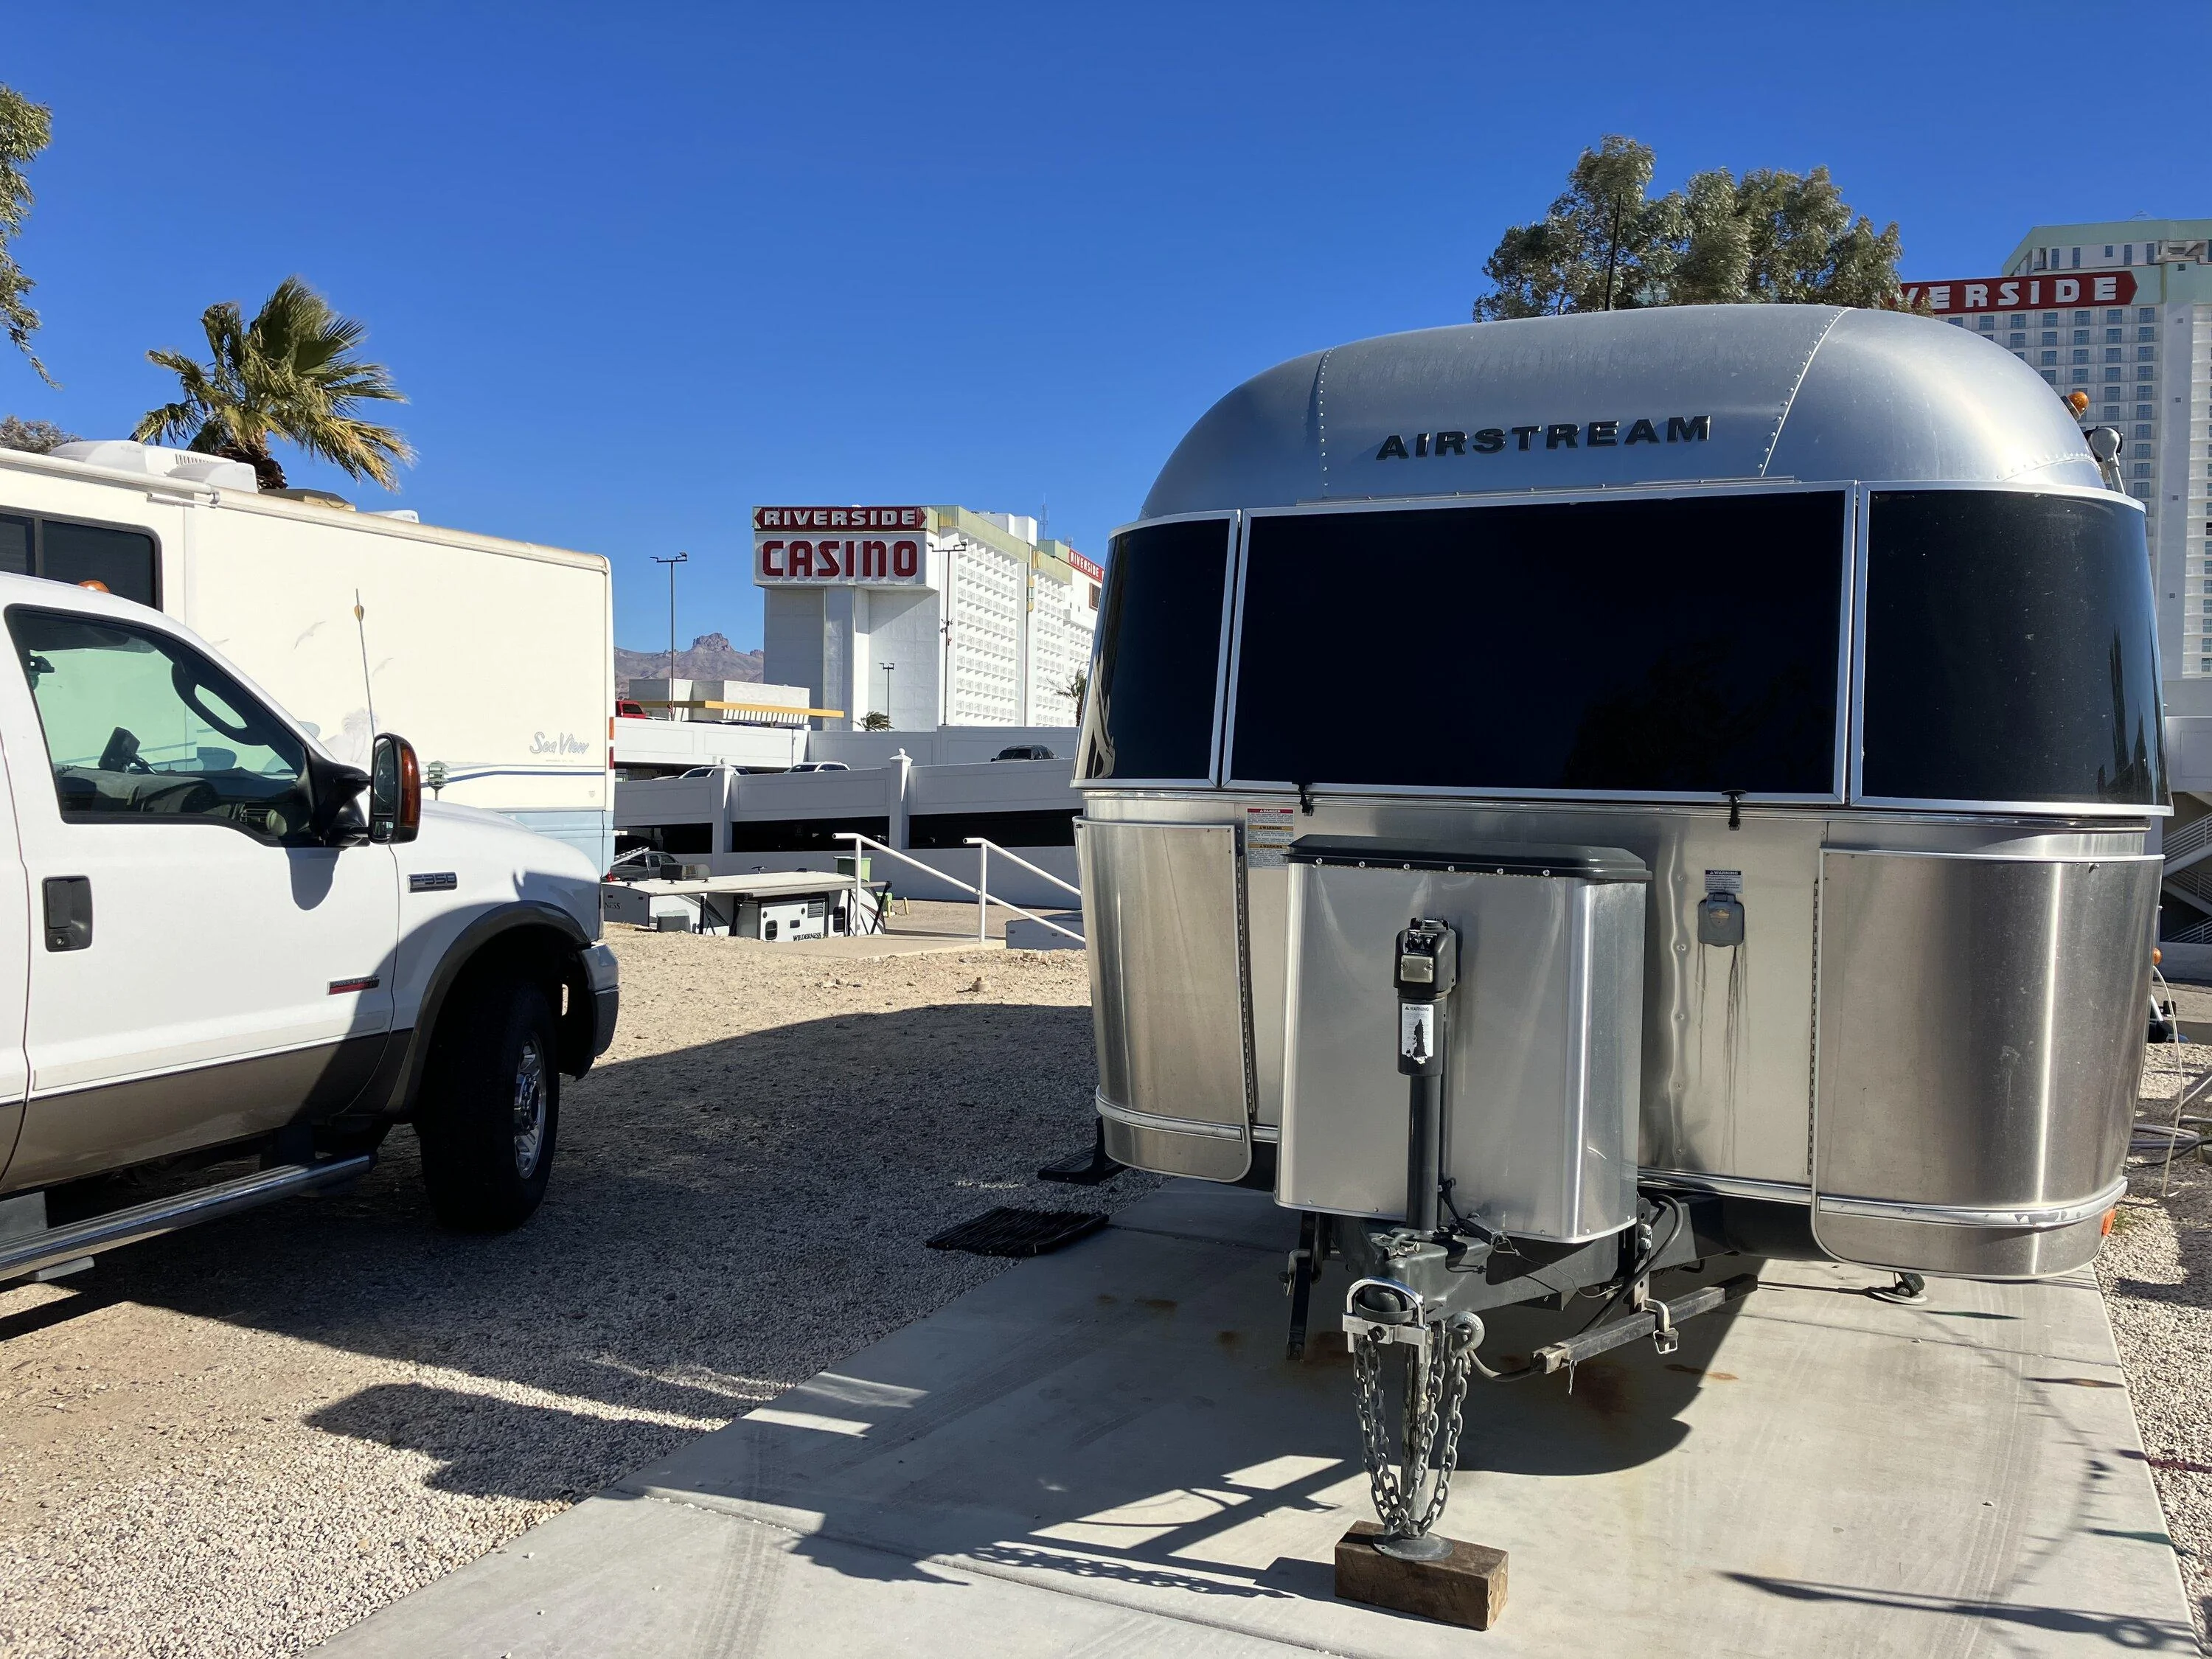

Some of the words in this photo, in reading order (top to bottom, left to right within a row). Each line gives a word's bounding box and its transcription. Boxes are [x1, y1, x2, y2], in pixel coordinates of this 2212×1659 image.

[1894, 276, 2117, 310] VERSIDE
[1376, 415, 1711, 460] AIRSTREAM
[764, 510, 916, 526] RIVERSIDE
[762, 540, 917, 577] CASINO
[1071, 551, 1099, 578] RIVERSIDE
[529, 731, 557, 754] Sea
[560, 732, 589, 755] View
[411, 873, 456, 885] F-350
[793, 932, 821, 942] WILDERNESS
